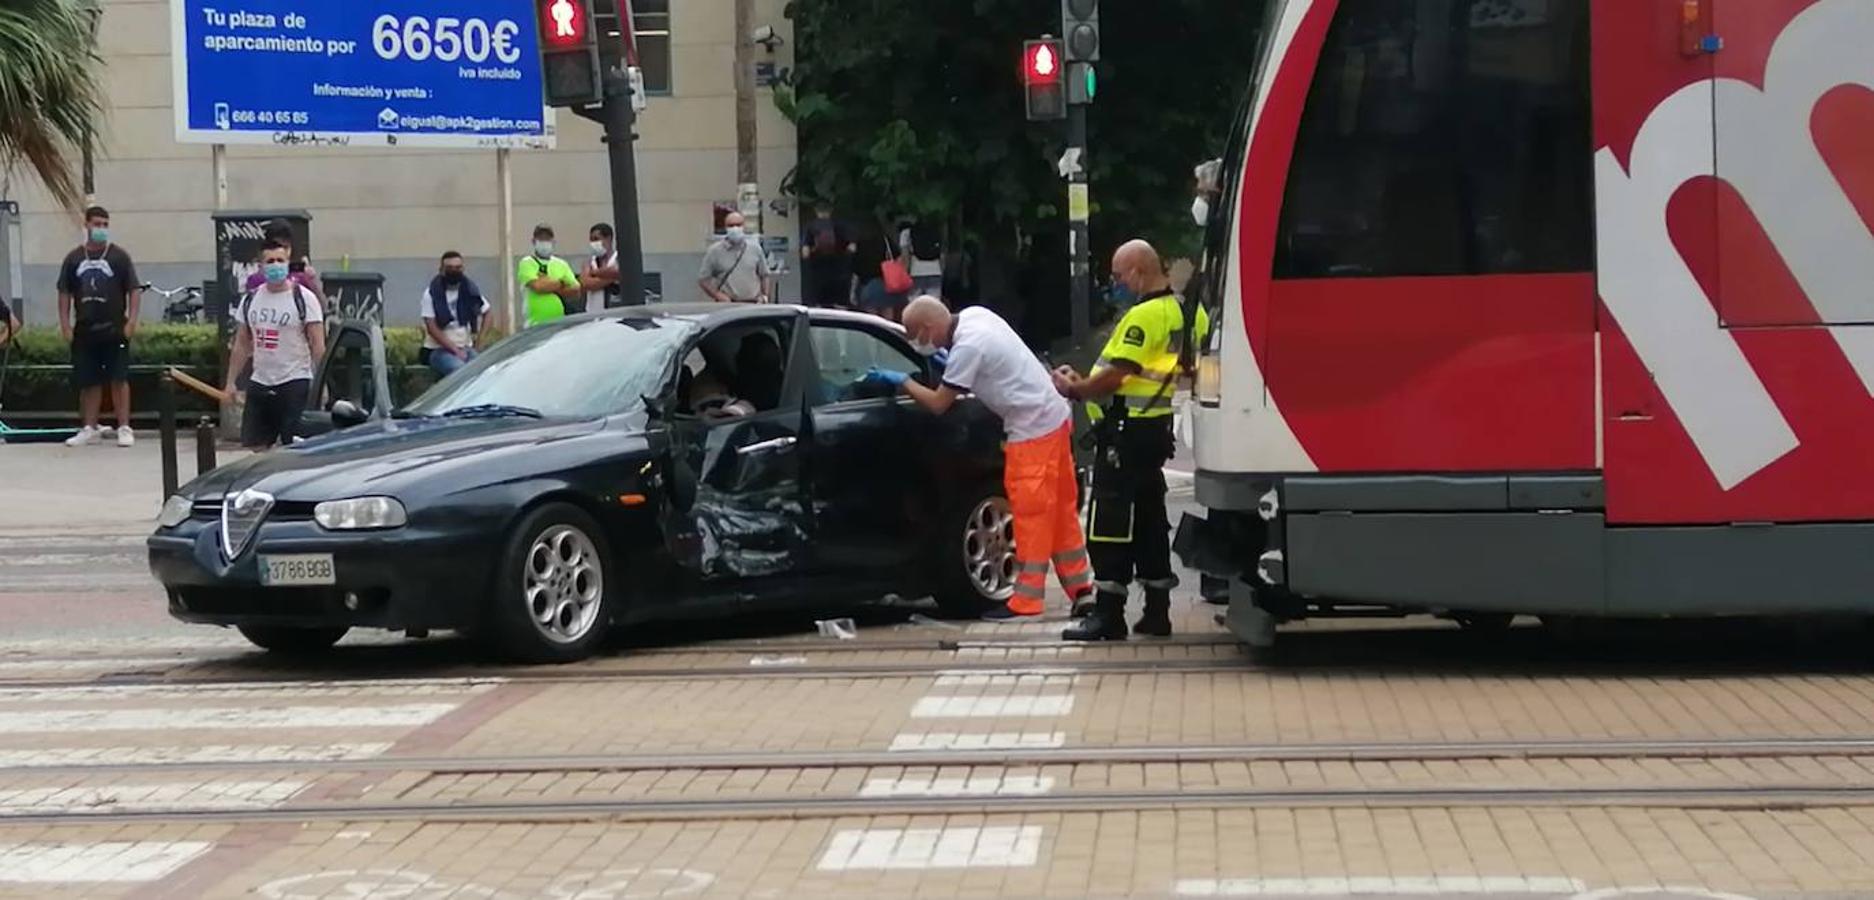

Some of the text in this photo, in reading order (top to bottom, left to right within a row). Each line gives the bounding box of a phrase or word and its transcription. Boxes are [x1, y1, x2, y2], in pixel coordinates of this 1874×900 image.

[203, 8, 306, 30] Tu plaza de
[204, 34, 357, 57] aparcamiento por
[372, 14, 521, 64] 6650€
[478, 67, 522, 81] incluido
[313, 83, 383, 98] Información
[384, 88, 392, 100] y
[394, 87, 427, 99] venta
[232, 110, 256, 123] 666
[257, 111, 274, 123] 40
[275, 111, 291, 124] 65
[250, 308, 291, 327] OSLO
